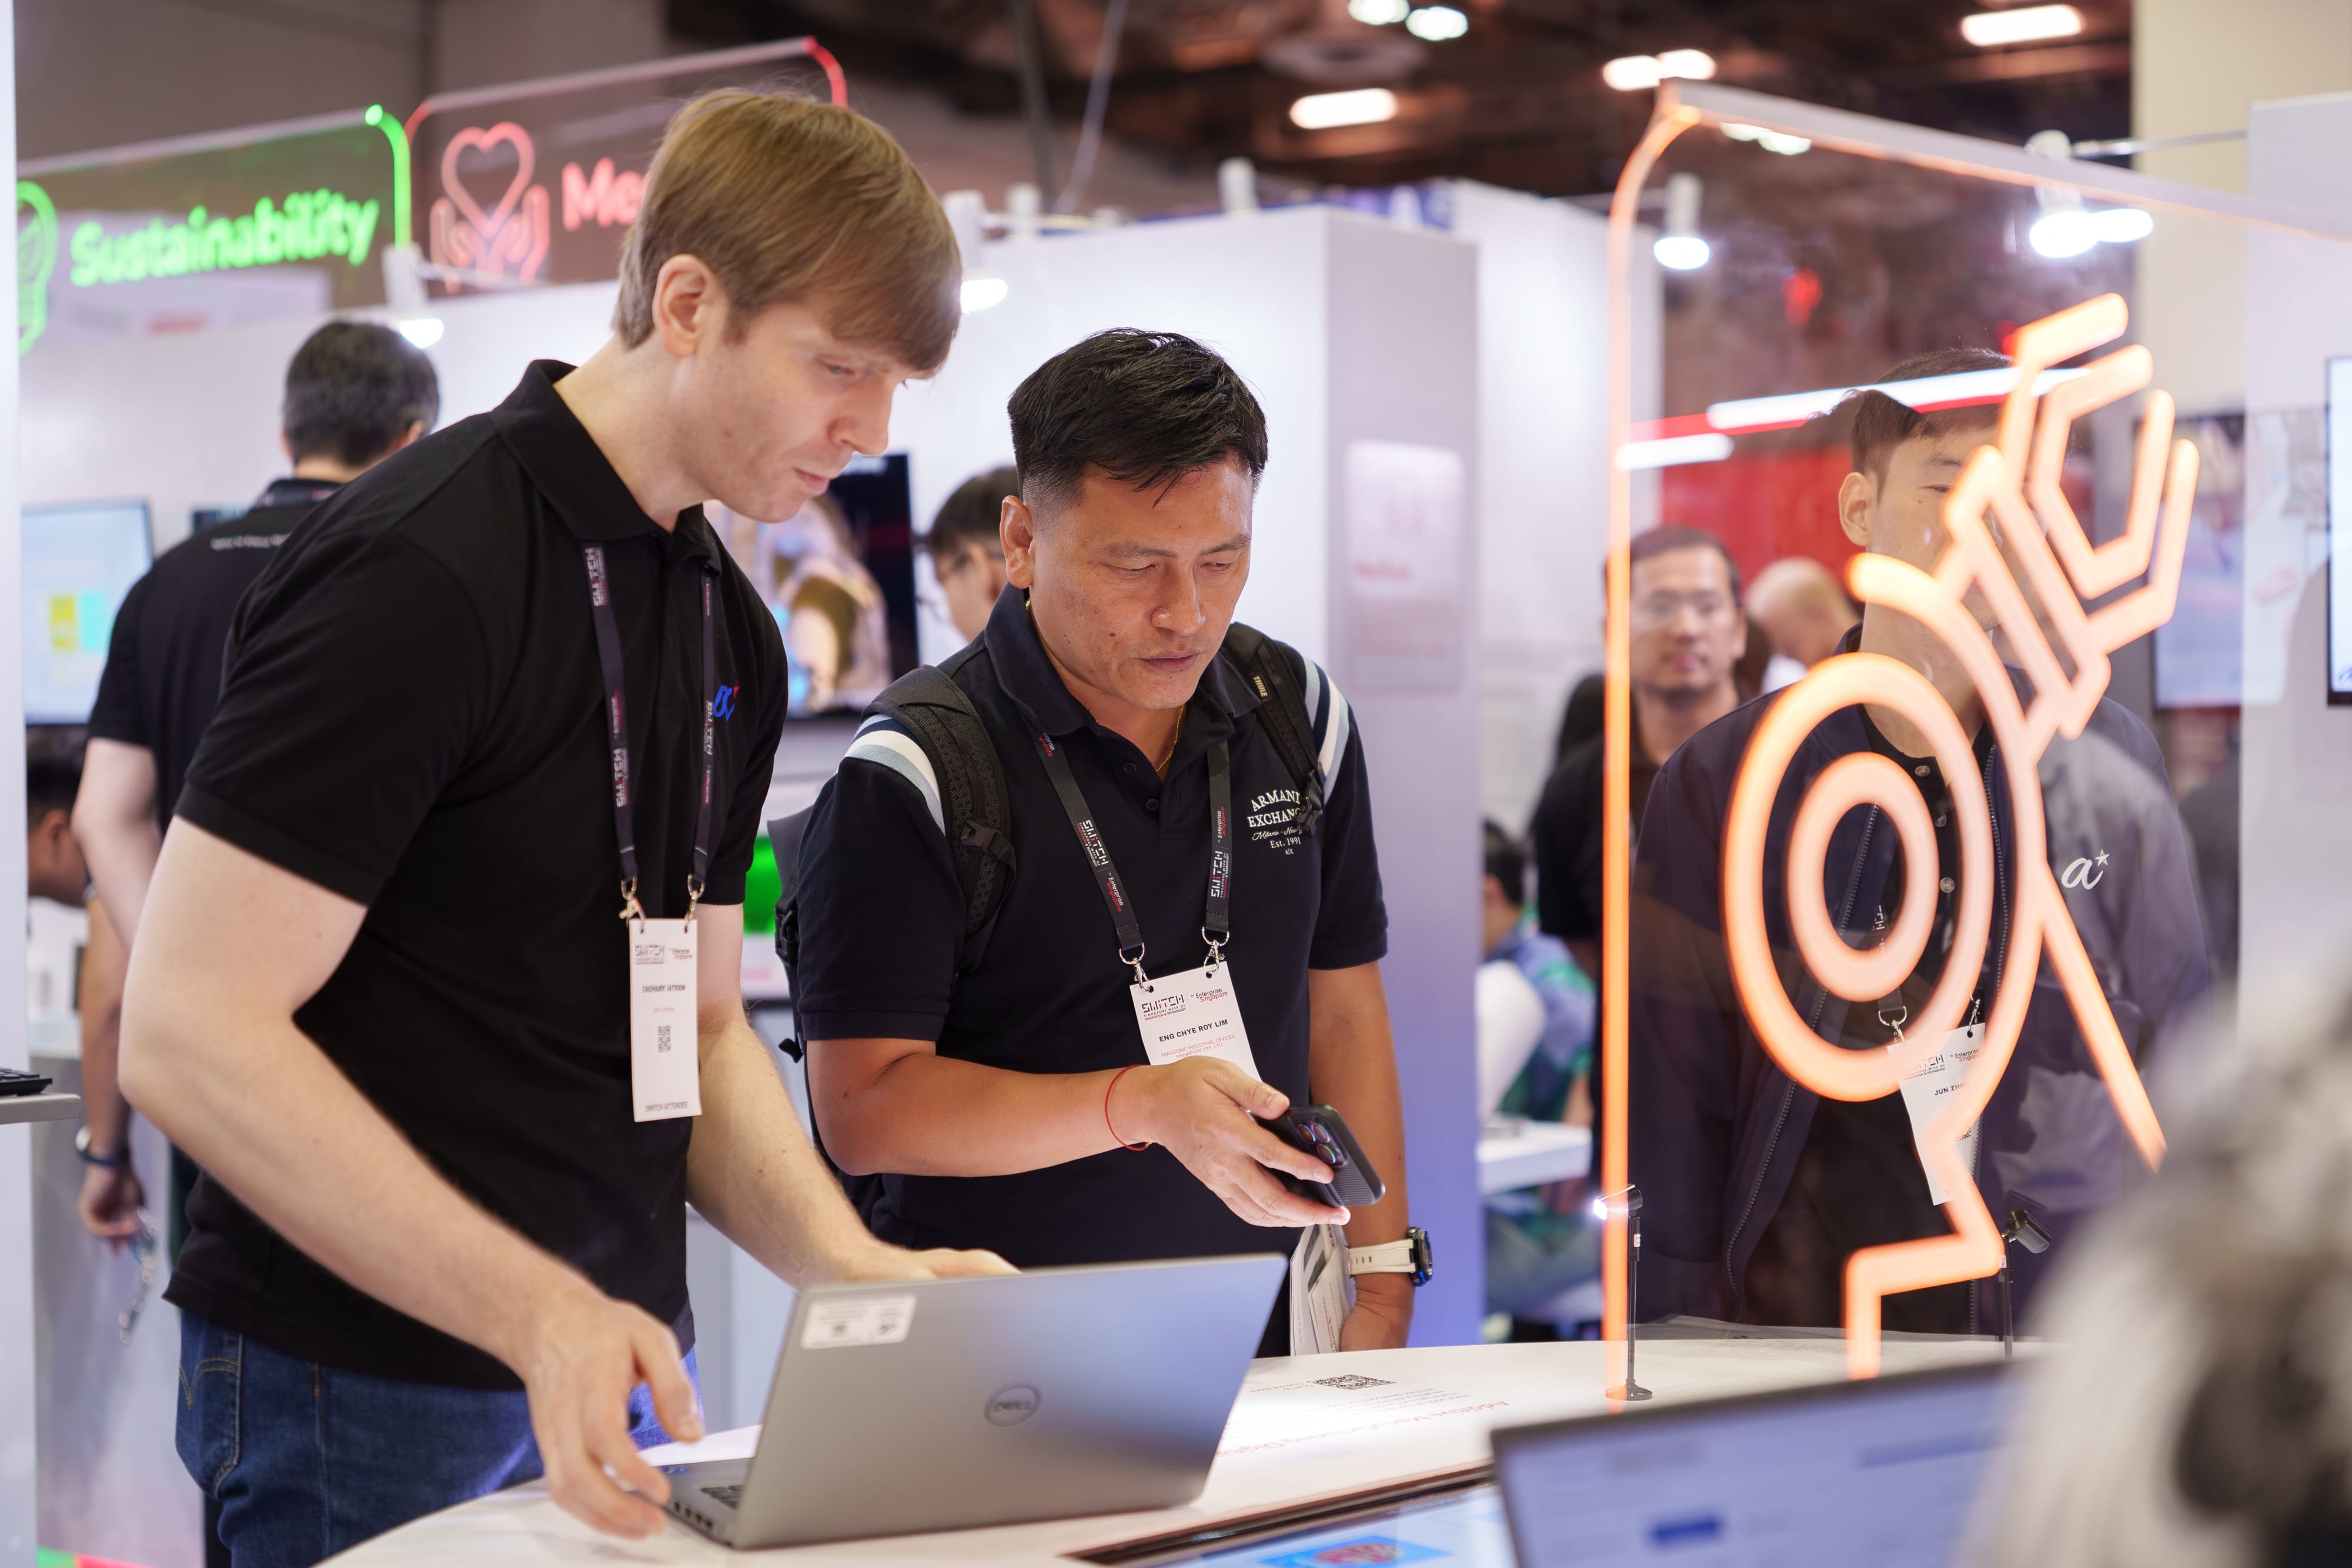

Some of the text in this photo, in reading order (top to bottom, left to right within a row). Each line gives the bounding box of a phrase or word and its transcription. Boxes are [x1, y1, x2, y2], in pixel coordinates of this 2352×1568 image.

[70, 188, 380, 287] Sustainability
[1253, 676, 1268, 697] THULE
[1251, 790, 1301, 812] ARMANI
[1252, 830, 1279, 841] Milano
[1284, 827, 1297, 835] New
[1270, 837, 1301, 848] Est. 1991
[1106, 881, 1121, 912] Singapore
[1108, 877, 1123, 906] Enterprise
[1195, 988, 1222, 999] Enterprise
[1200, 991, 1228, 1002] Singapore
[1144, 1009, 1167, 1018] SINGAPORE
[1144, 1013, 1164, 1021] INNOVATION
[1167, 1008, 1186, 1016] TECHNOLOGY
[1159, 1019, 1228, 1042] ENG CHYE ROY LIM
[1161, 1034, 1235, 1058] PANASONIC INDUSTRIAL DEVICES
[1175, 1048, 1202, 1059] SINGAPORE
[1955, 1049, 1980, 1059] Enterprise
[1935, 1086, 1950, 1096] JUN
[1430, 1400, 1510, 1416] Additive
